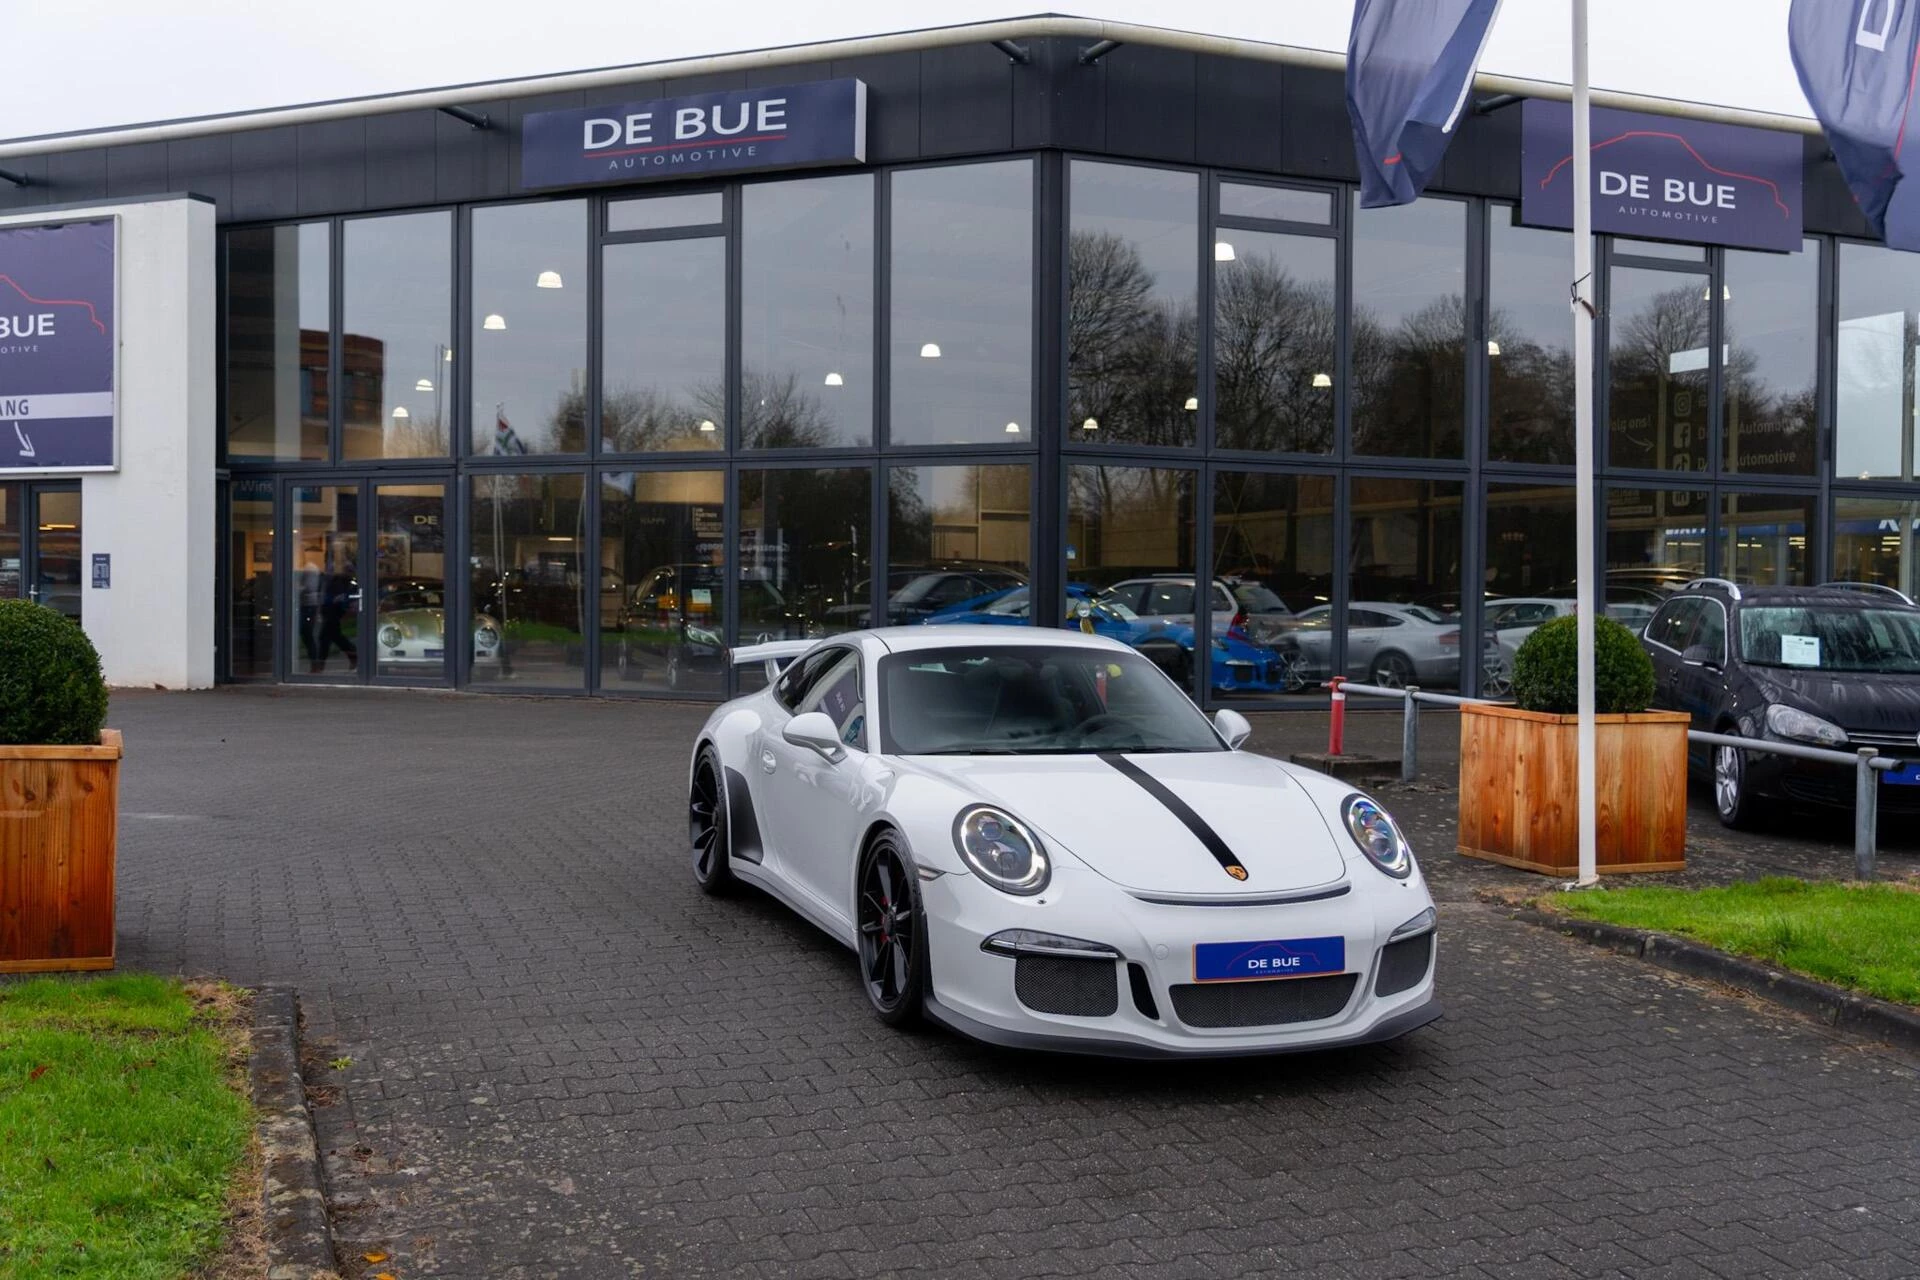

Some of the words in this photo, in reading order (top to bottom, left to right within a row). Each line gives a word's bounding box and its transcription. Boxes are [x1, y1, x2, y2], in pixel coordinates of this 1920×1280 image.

[583, 112, 653, 150] DE
[674, 98, 787, 140] BUE
[608, 146, 757, 170] AUTOMOTIVE
[1599, 170, 1650, 199] DE
[1663, 178, 1736, 209] BUE
[1618, 205, 1719, 224] AUTOMOTIVE
[413, 514, 439, 525] DE
[1247, 959, 1268, 969] DE
[1272, 956, 1301, 968] BUE
